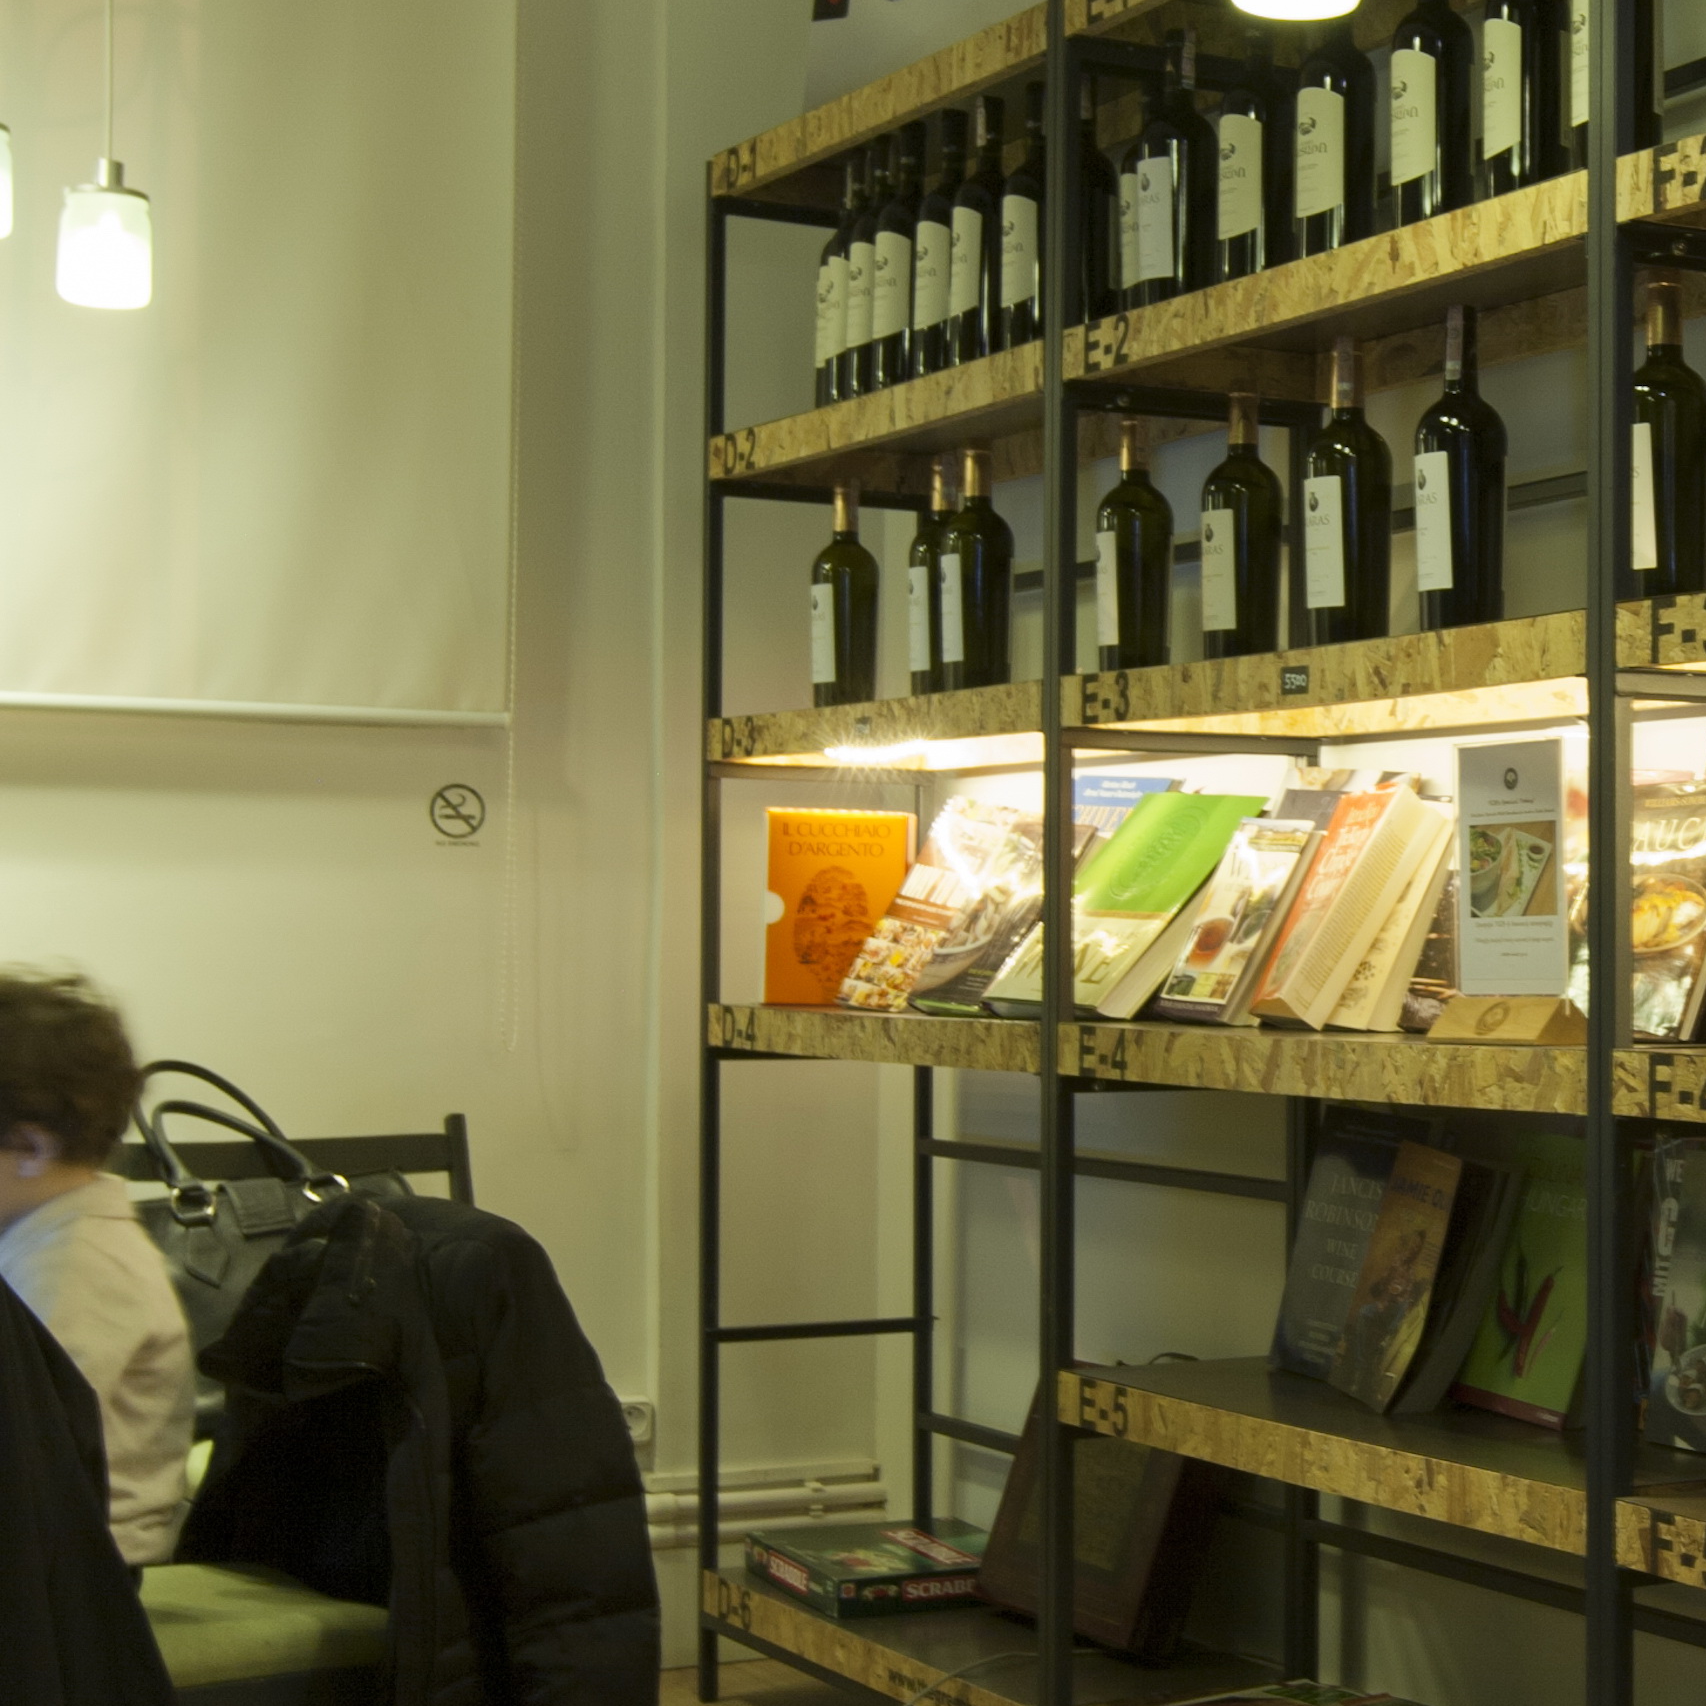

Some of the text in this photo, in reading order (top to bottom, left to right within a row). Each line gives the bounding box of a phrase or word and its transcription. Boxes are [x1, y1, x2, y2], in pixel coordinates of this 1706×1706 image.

[726, 138, 757, 190] D-1
[1084, 312, 1130, 375] E-2
[724, 427, 756, 476] D-2
[1081, 671, 1130, 724] E-3
[721, 715, 756, 758] D-3
[783, 822, 891, 838] IL CUCCHIAIO
[789, 842, 885, 857] D'ARGENTO
[722, 1006, 757, 1050] D-4
[1079, 1025, 1128, 1081] E-4
[1079, 1377, 1128, 1437] E-5
[717, 1577, 752, 1632] D-6
